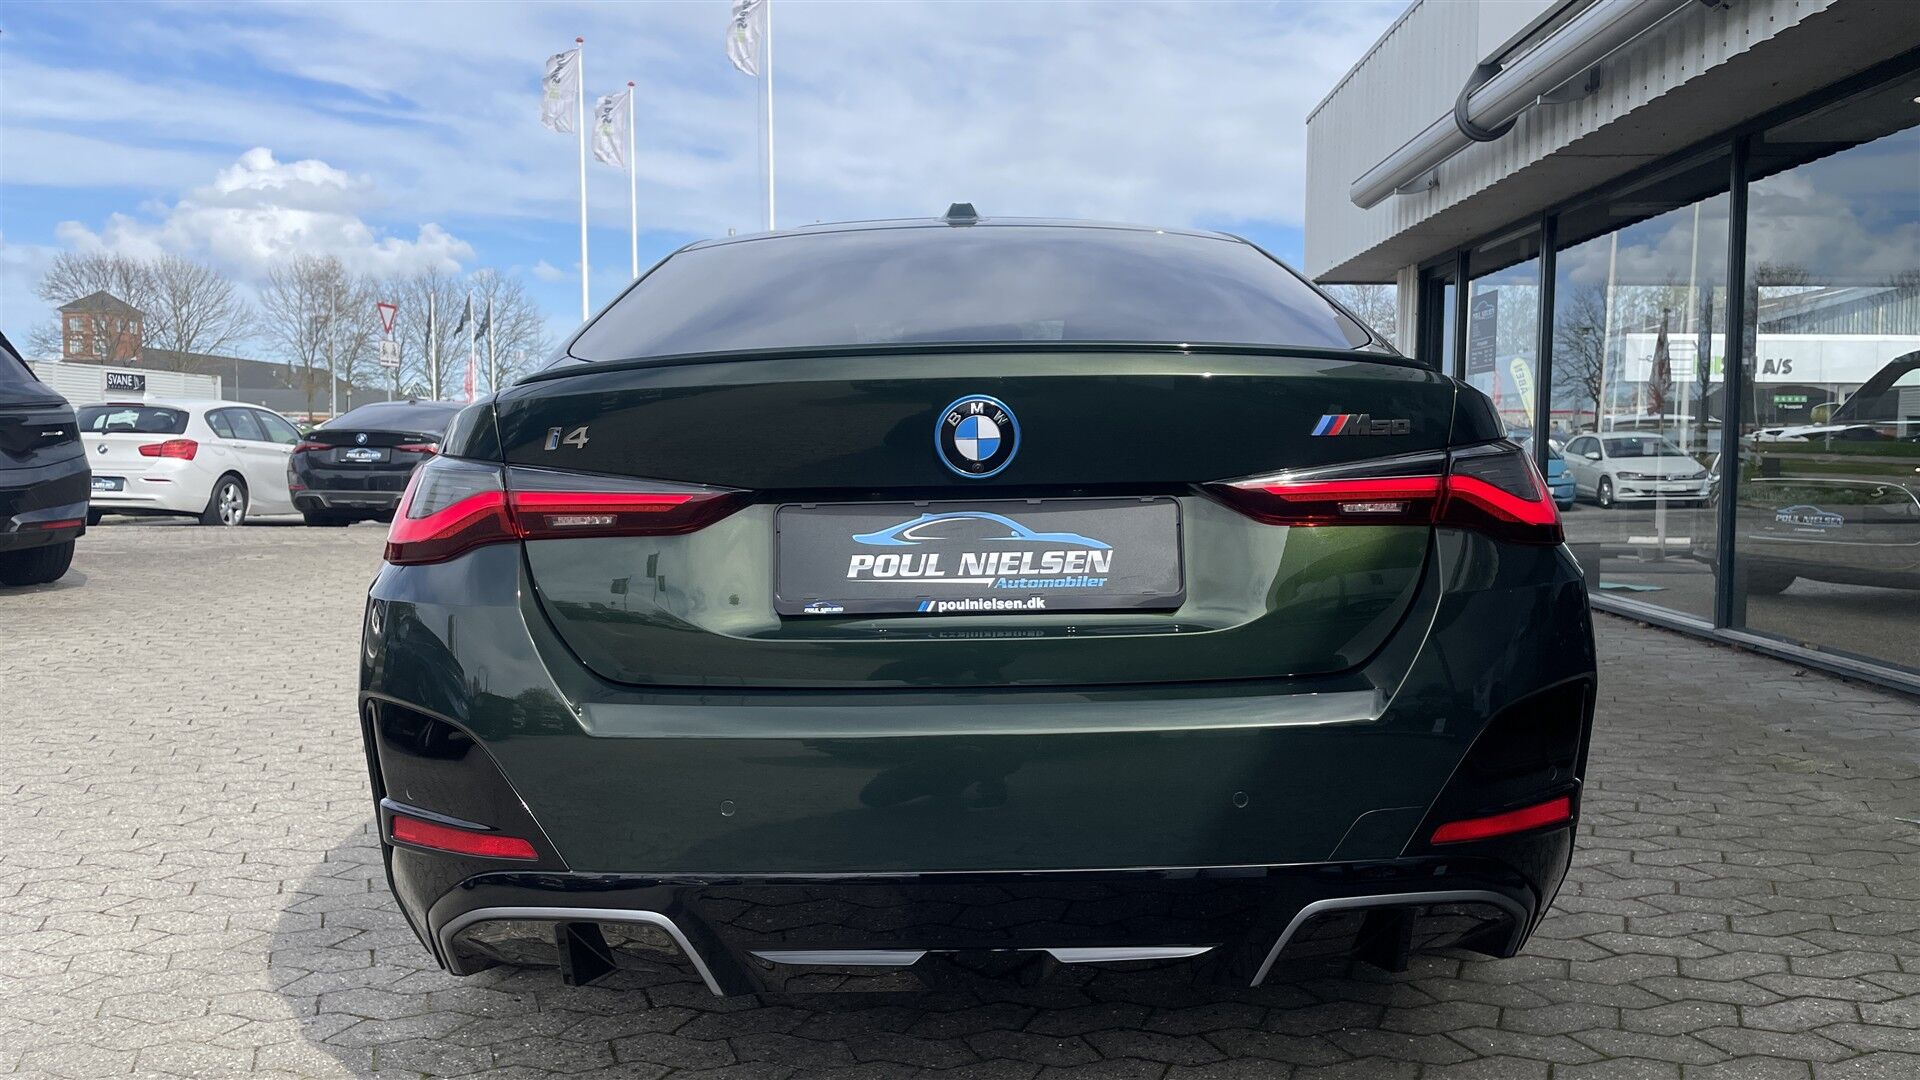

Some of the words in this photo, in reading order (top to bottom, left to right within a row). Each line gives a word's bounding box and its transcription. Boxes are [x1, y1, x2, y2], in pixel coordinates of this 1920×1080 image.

[1762, 358, 1793, 375] A/S
[108, 373, 133, 387] SVANE
[946, 402, 1009, 427] BMW
[1337, 413, 1411, 436] M50
[544, 425, 591, 451] i4
[847, 553, 945, 578] POUL
[958, 550, 1113, 576] NIELSEN
[994, 576, 1107, 589] Automobiler
[937, 597, 1046, 613] poulnielsen.dk
